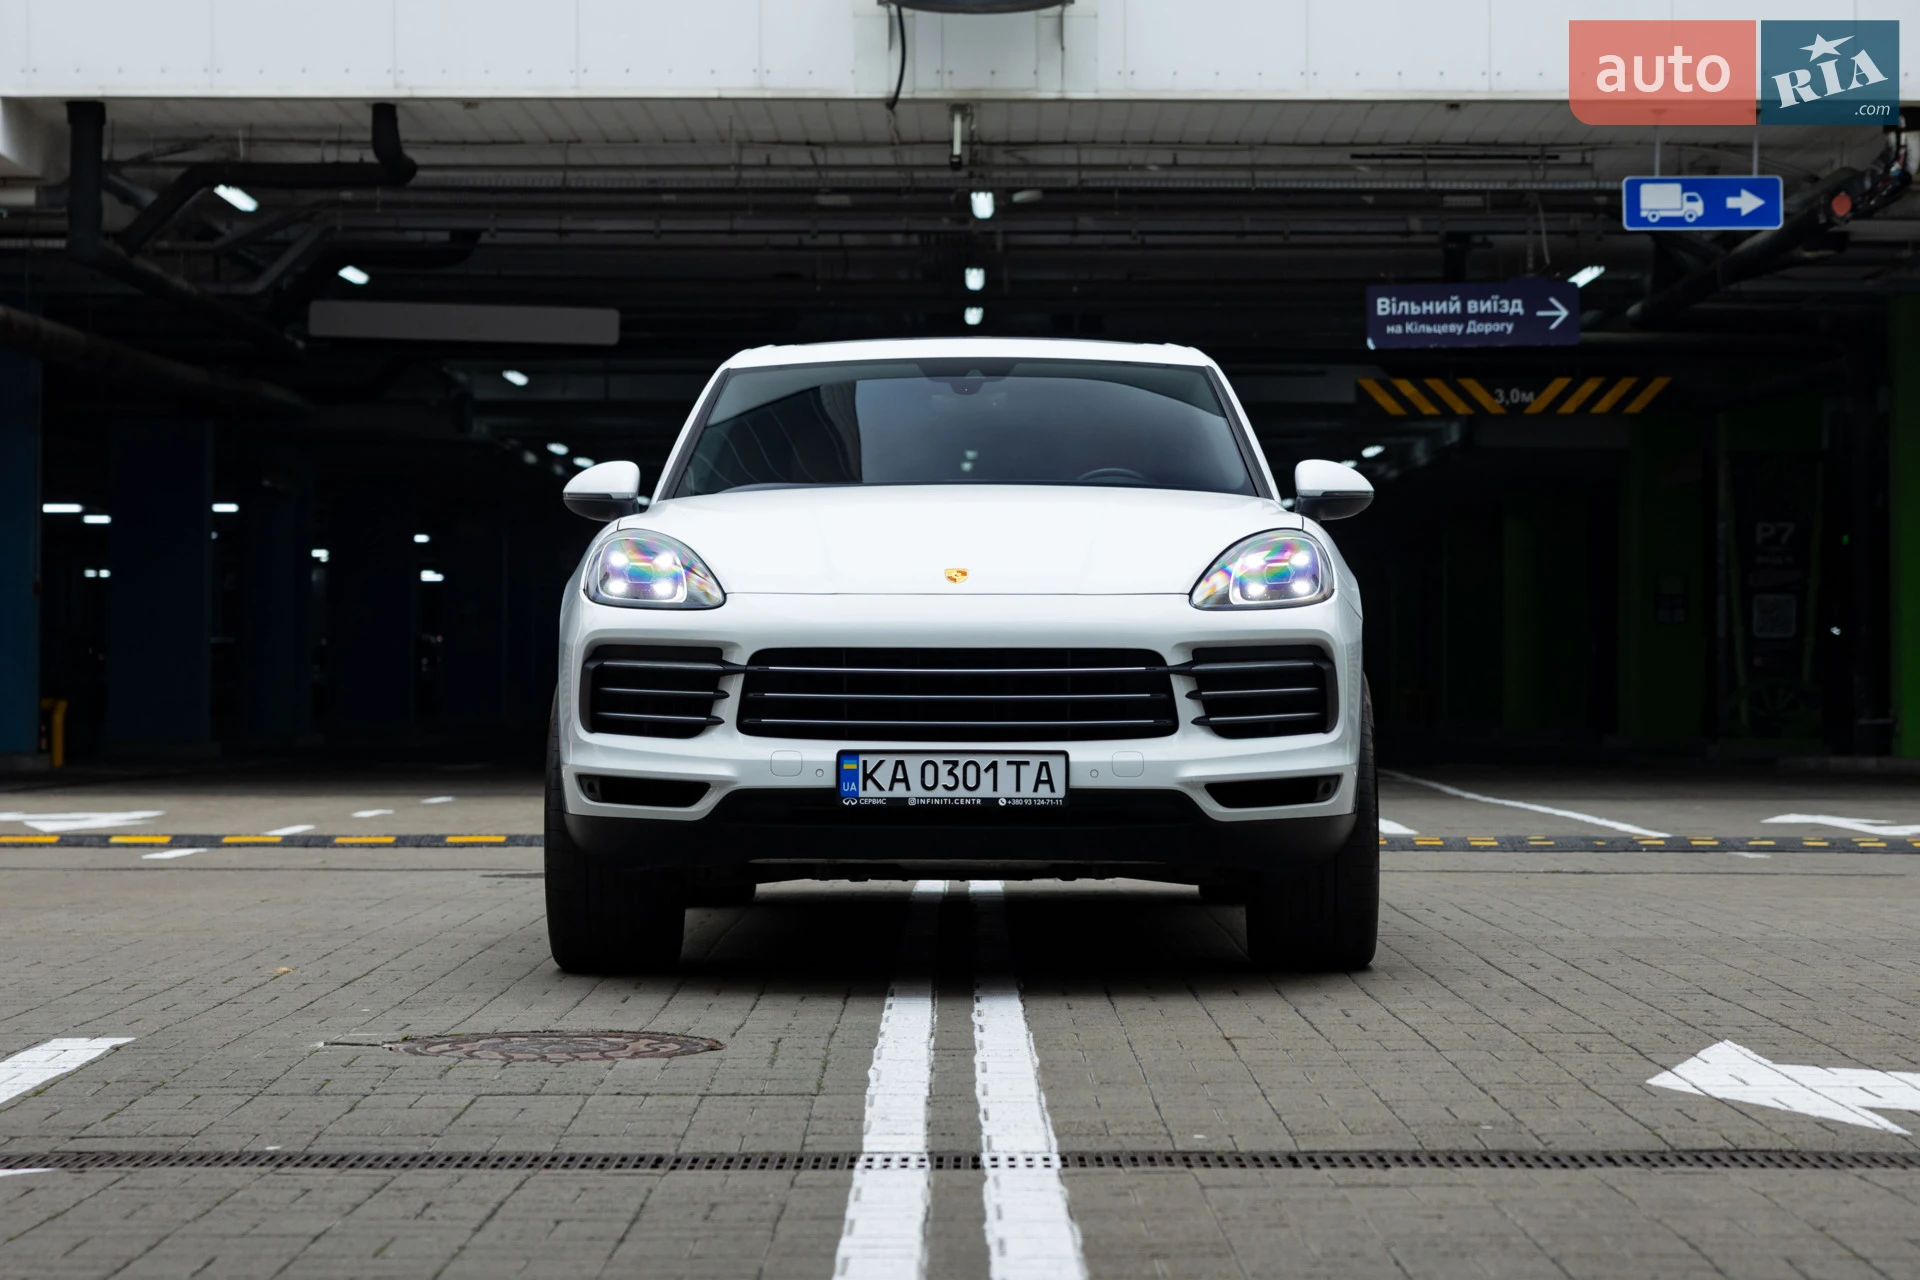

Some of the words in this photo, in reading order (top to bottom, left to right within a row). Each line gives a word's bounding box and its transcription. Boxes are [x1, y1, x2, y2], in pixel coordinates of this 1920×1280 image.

[1376, 296, 1462, 316] Вільний
[1467, 295, 1525, 316] виїзд
[1386, 324, 1402, 334] на
[1405, 321, 1463, 336] Кільцеву
[1466, 319, 1515, 335] Дорогу
[1754, 520, 1797, 545] P7
[861, 759, 912, 792] KA
[920, 760, 999, 792] 0301
[1006, 760, 1056, 793] TA
[842, 782, 857, 792] UA
[1007, 798, 1024, 806] +380
[1024, 798, 1033, 806] 93
